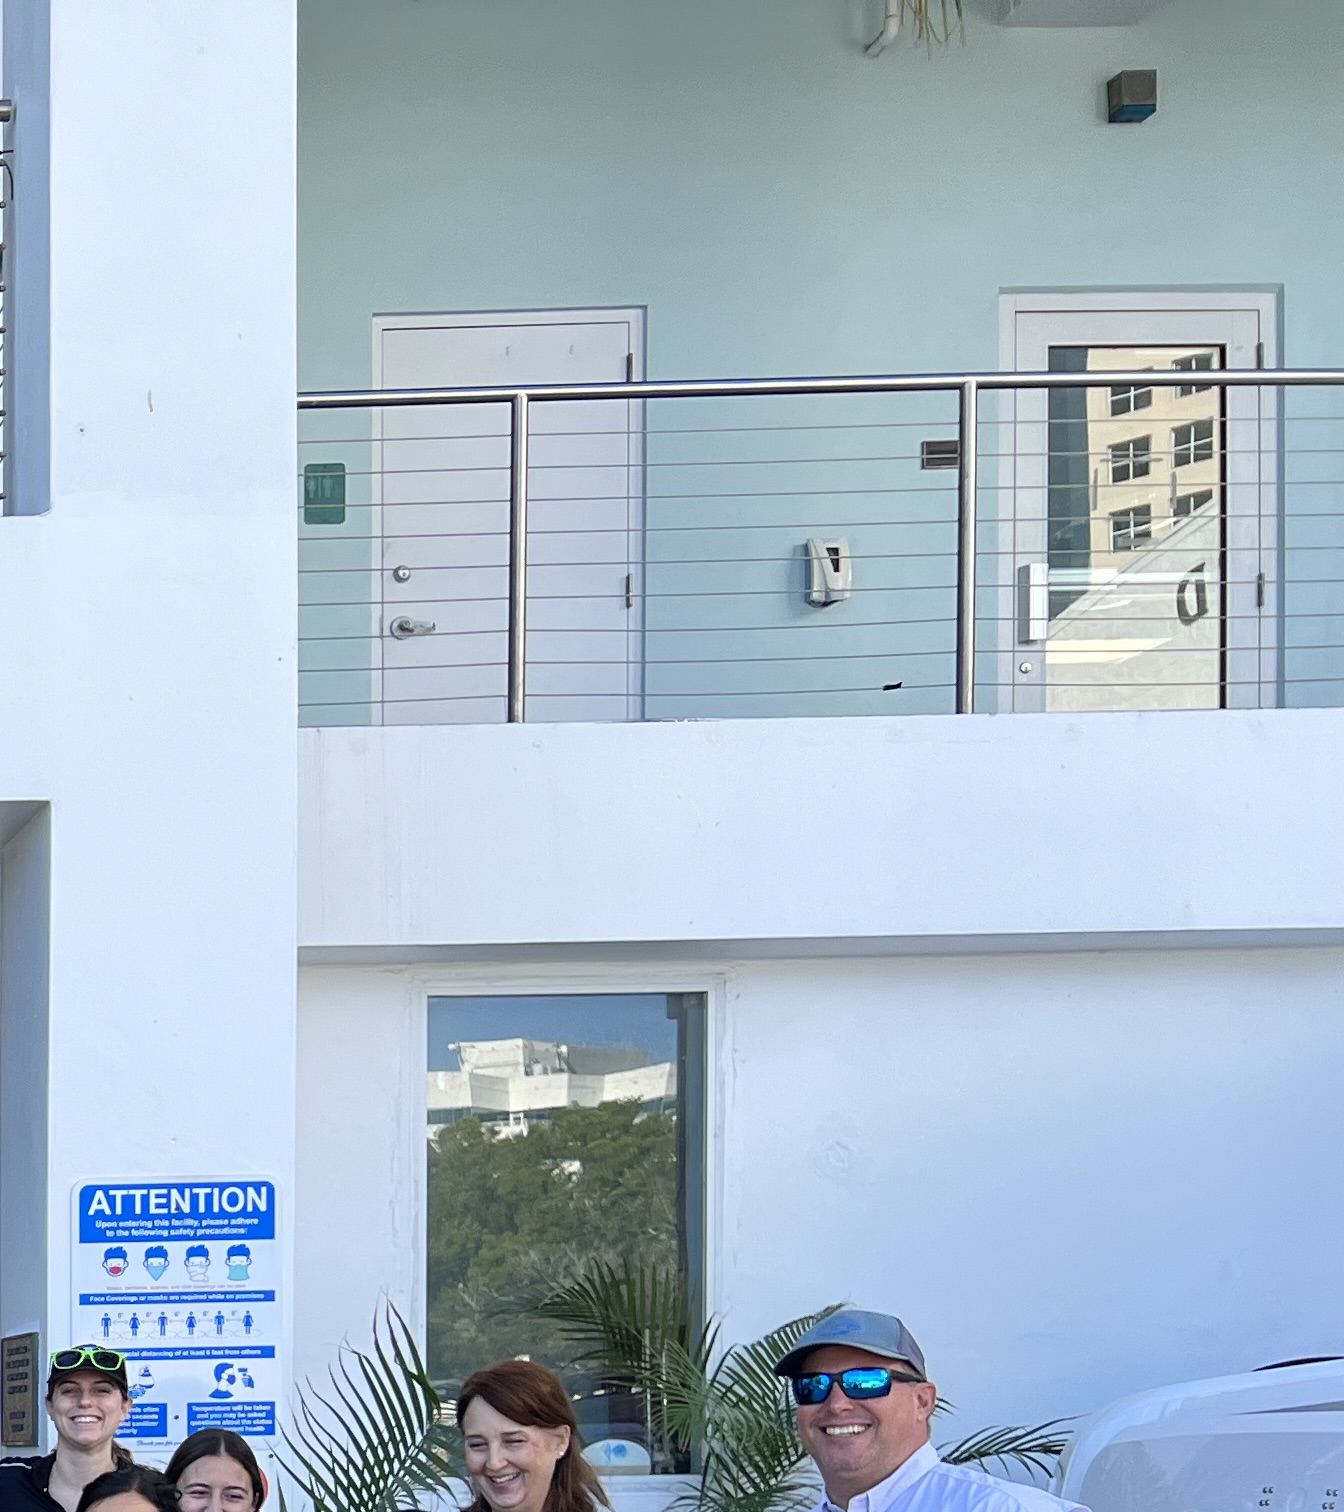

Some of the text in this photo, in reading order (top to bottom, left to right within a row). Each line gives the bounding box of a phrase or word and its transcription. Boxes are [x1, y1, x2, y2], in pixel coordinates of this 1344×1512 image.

[88, 1186, 267, 1215] ATTENTION
[95, 1220, 117, 1229] Upon
[119, 1219, 152, 1229] entering
[154, 1219, 169, 1227] this
[202, 1217, 229, 1227] please
[230, 1217, 259, 1226] adhere
[105, 1229, 115, 1237] to
[116, 1229, 129, 1237] the
[131, 1228, 169, 1237] following
[170, 1228, 195, 1237] safety
[141, 1350, 174, 1358] distancing
